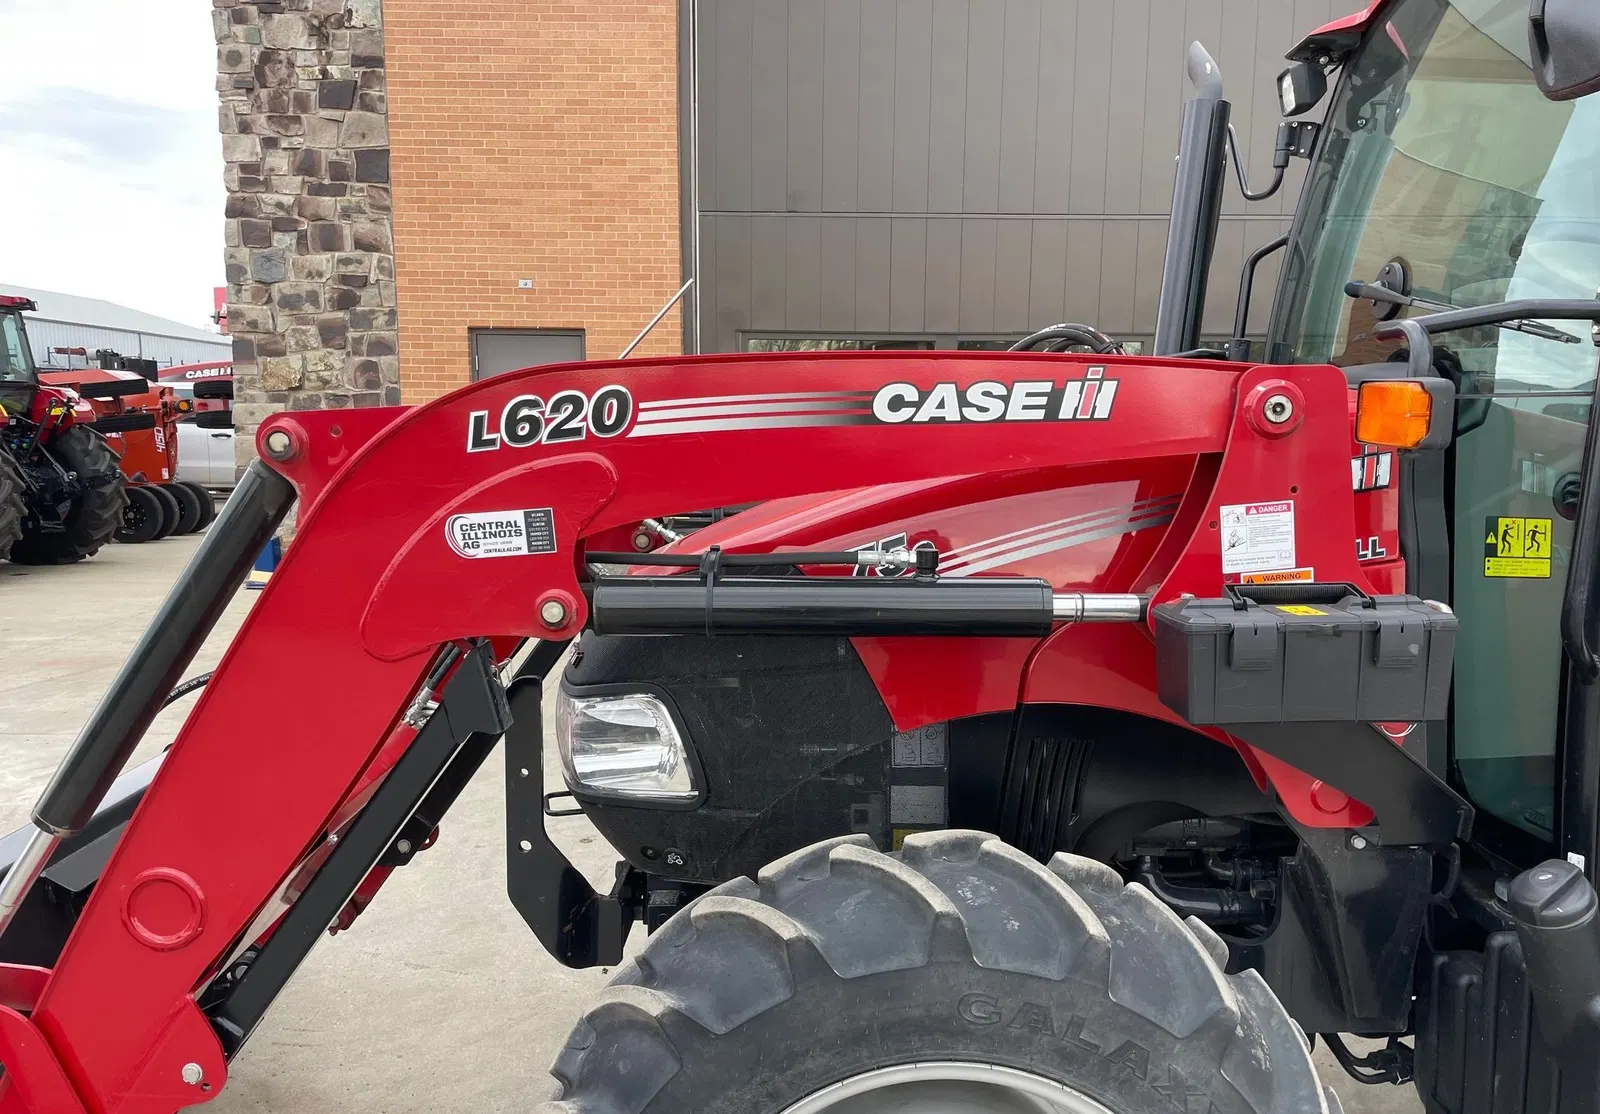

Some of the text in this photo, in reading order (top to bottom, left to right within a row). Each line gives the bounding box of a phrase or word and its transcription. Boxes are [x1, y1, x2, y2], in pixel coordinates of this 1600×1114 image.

[185, 368, 219, 379] CASE
[872, 381, 1054, 423] CASE
[467, 384, 633, 453] L620
[154, 426, 166, 453] 4150
[1258, 504, 1288, 514] DANGER
[459, 520, 522, 533] CENTRAL
[461, 529, 523, 541] ILLINOIS
[463, 540, 480, 550] AG
[1262, 573, 1302, 582] WARNING
